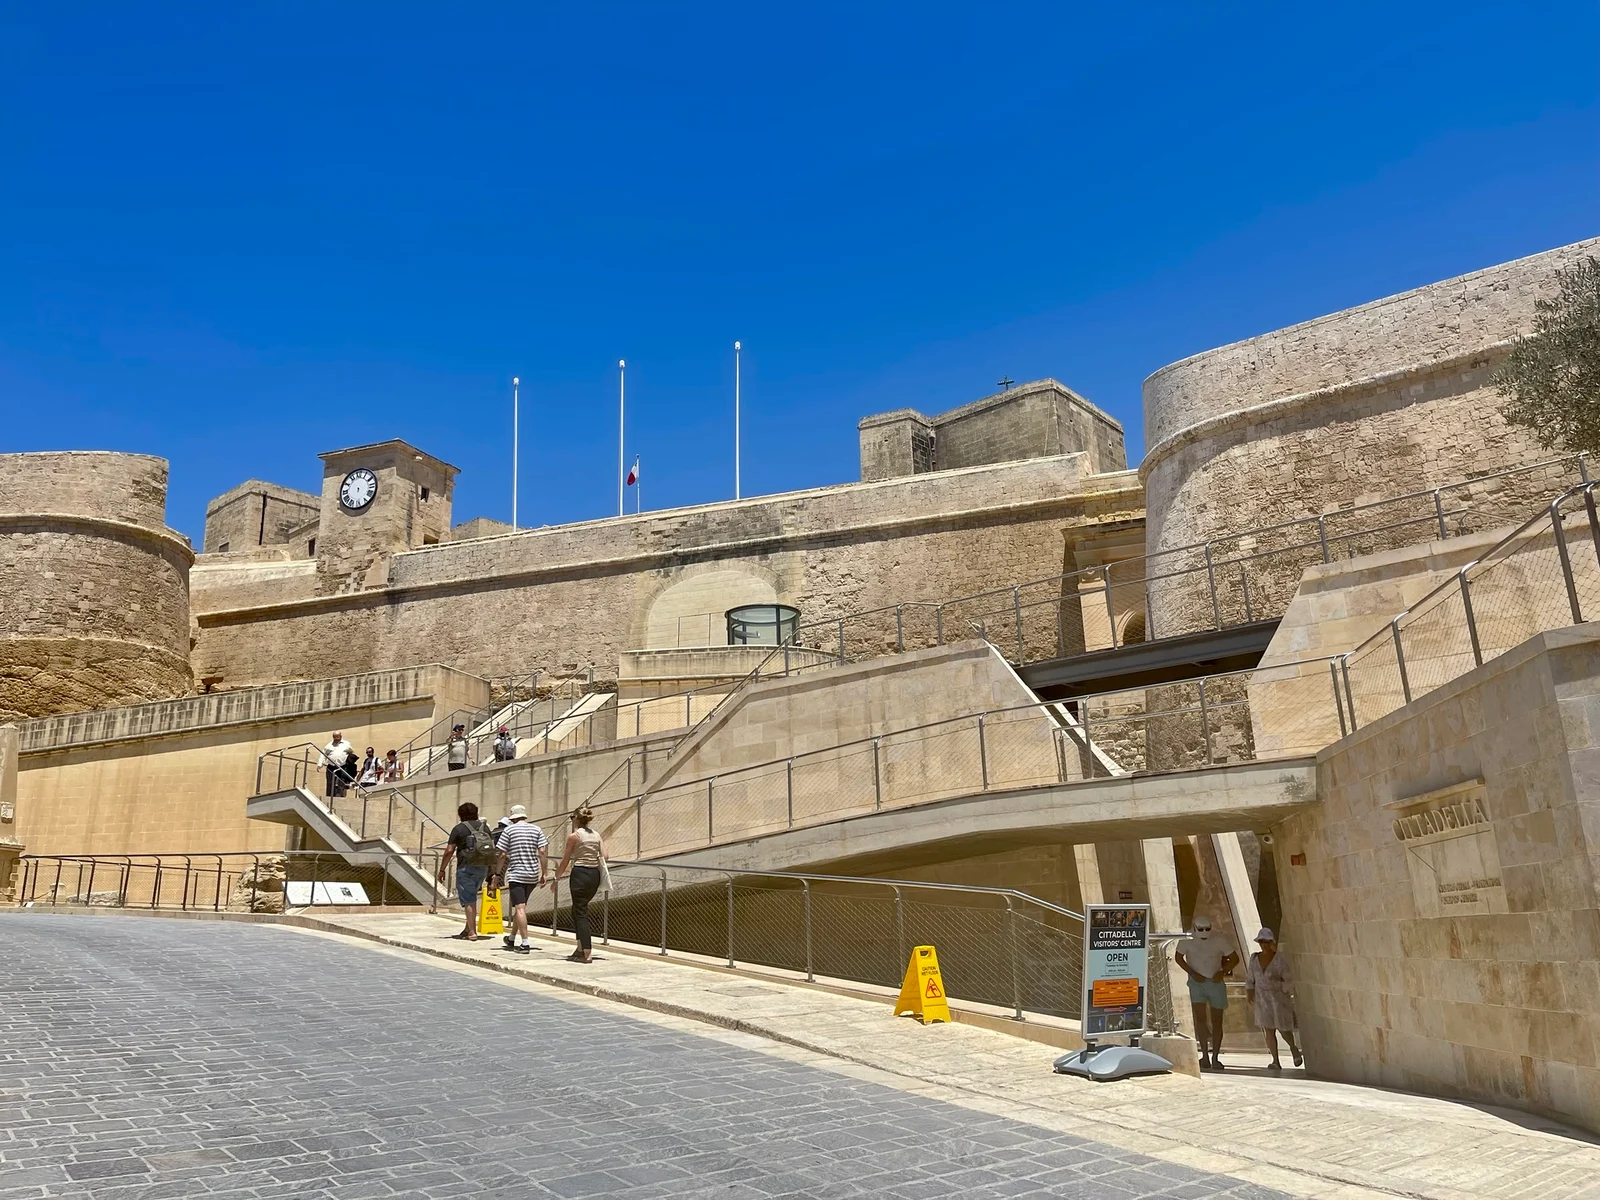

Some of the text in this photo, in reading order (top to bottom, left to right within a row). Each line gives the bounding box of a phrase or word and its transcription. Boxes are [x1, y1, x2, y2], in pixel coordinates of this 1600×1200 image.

[1392, 799, 1490, 841] CITTADELLA
[1098, 930, 1137, 939] CITTADELLA
[1106, 952, 1128, 962] OPEN
